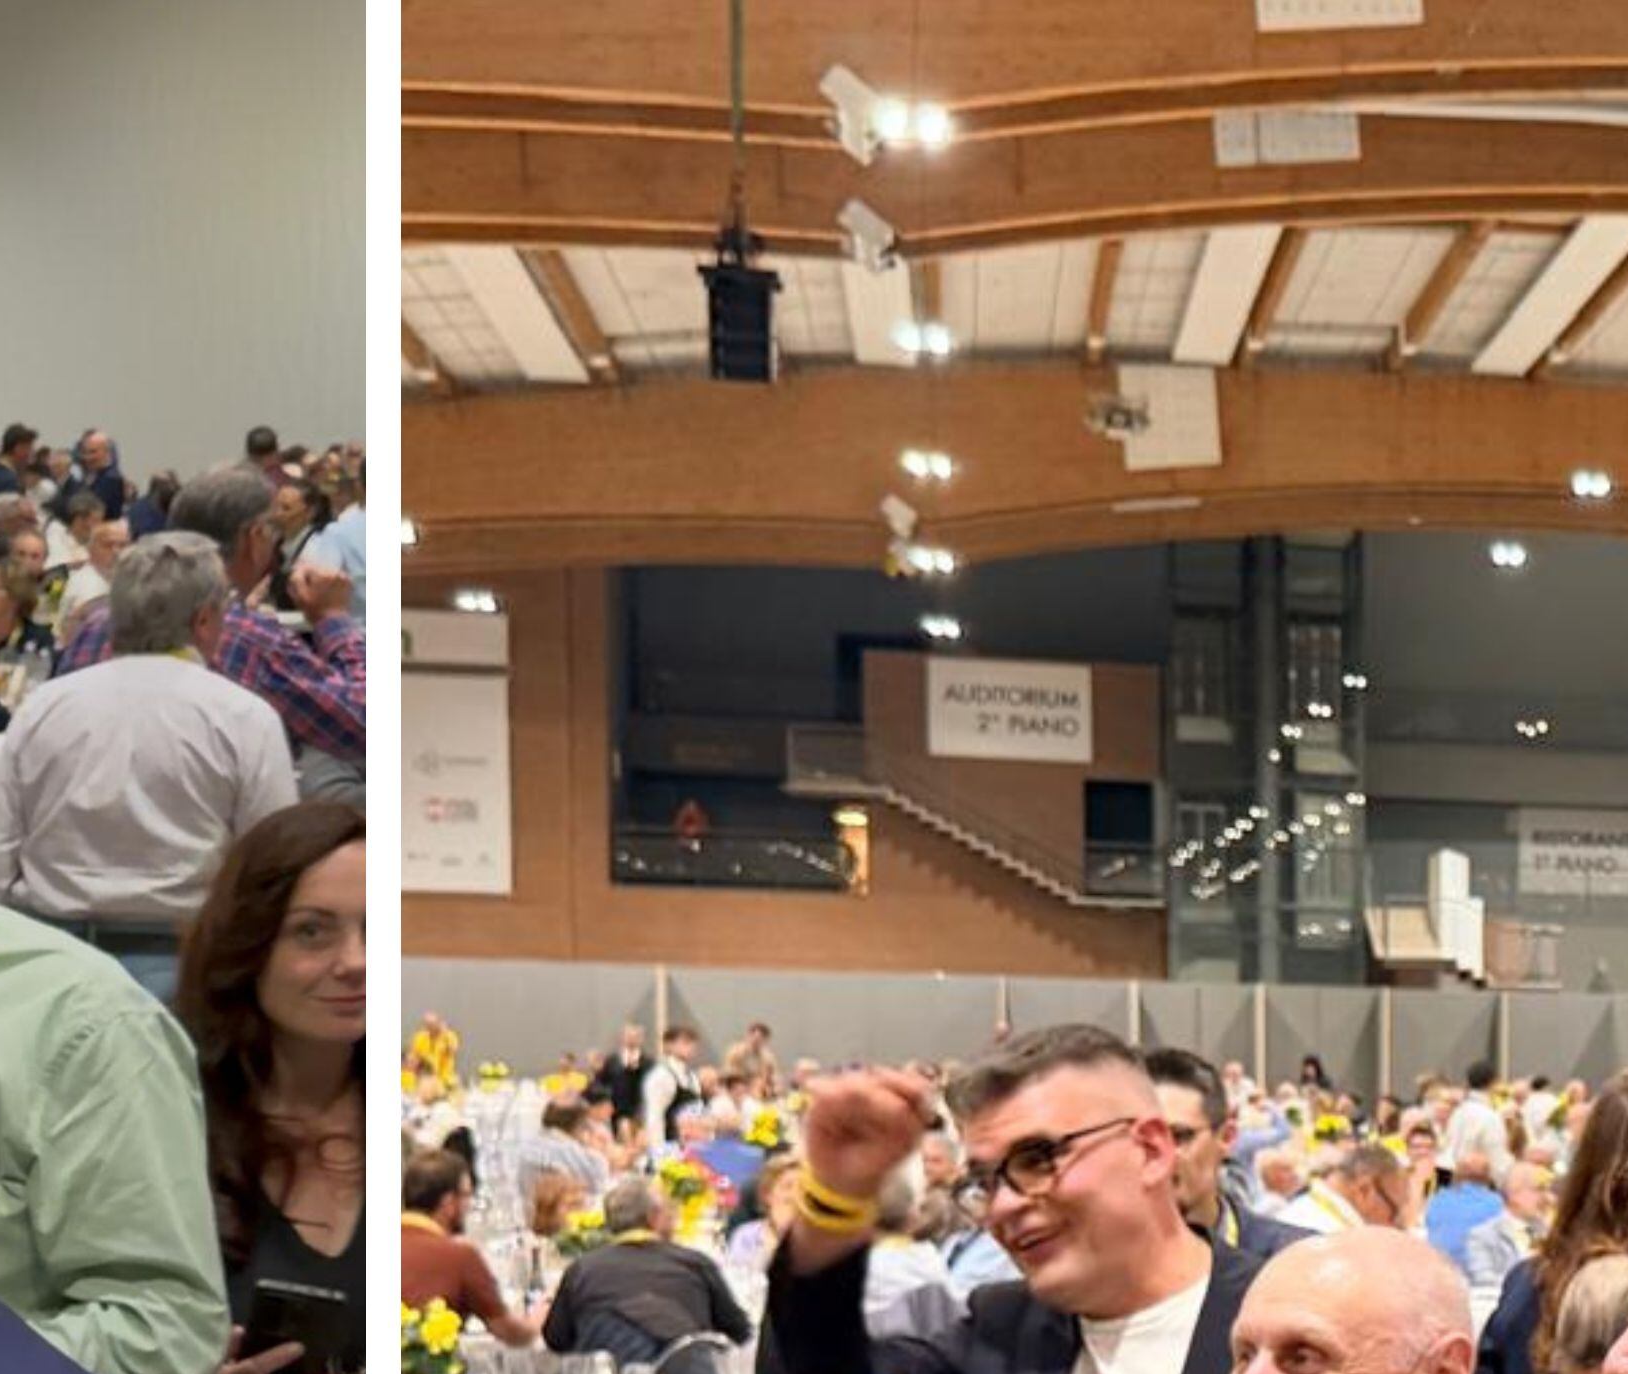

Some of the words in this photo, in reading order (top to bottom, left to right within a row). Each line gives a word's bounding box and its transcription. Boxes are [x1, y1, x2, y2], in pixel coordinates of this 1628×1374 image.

[943, 683, 1080, 709] AUDITORIUM
[1008, 715, 1080, 738] PIANO
[1556, 854, 1616, 874] PIANO
